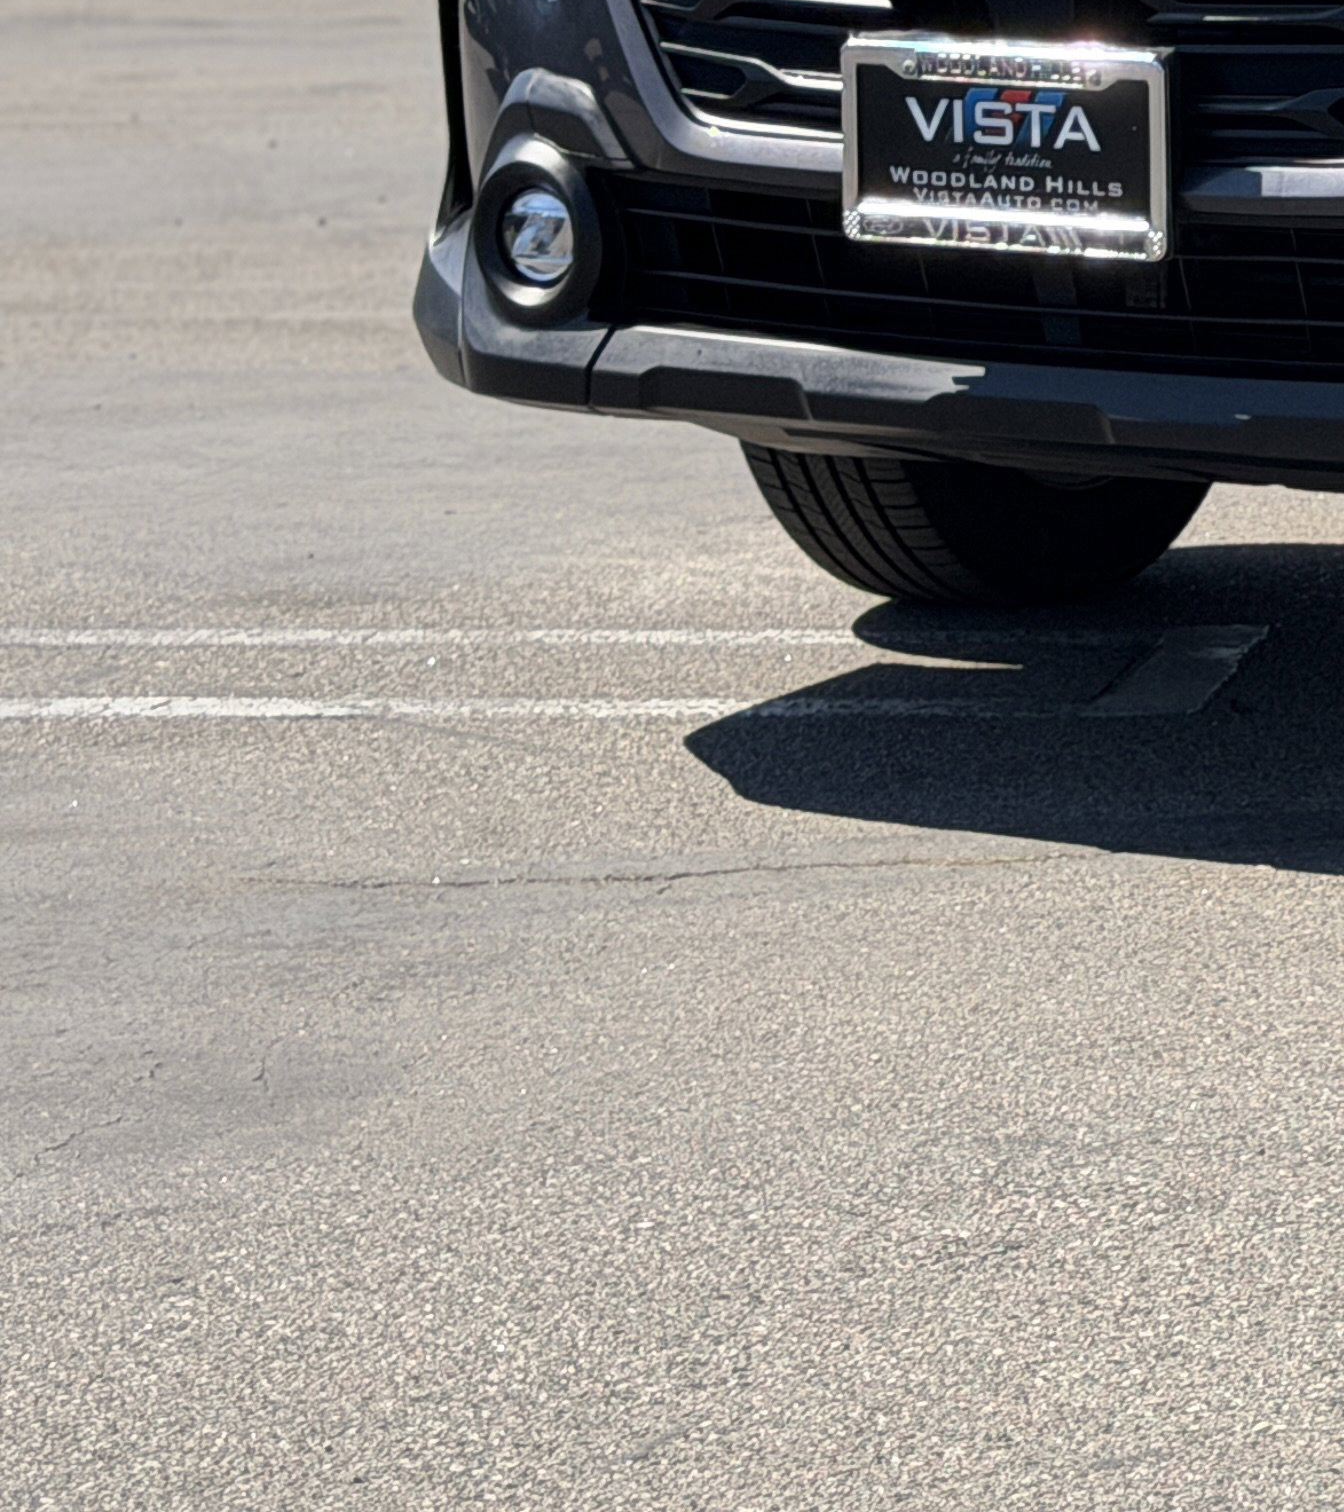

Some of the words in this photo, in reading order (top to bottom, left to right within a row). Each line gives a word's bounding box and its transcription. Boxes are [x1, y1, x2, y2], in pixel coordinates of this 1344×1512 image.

[905, 96, 1101, 152] VISTA
[889, 165, 1035, 192] WOODLAND
[1045, 175, 1124, 198] HILLS
